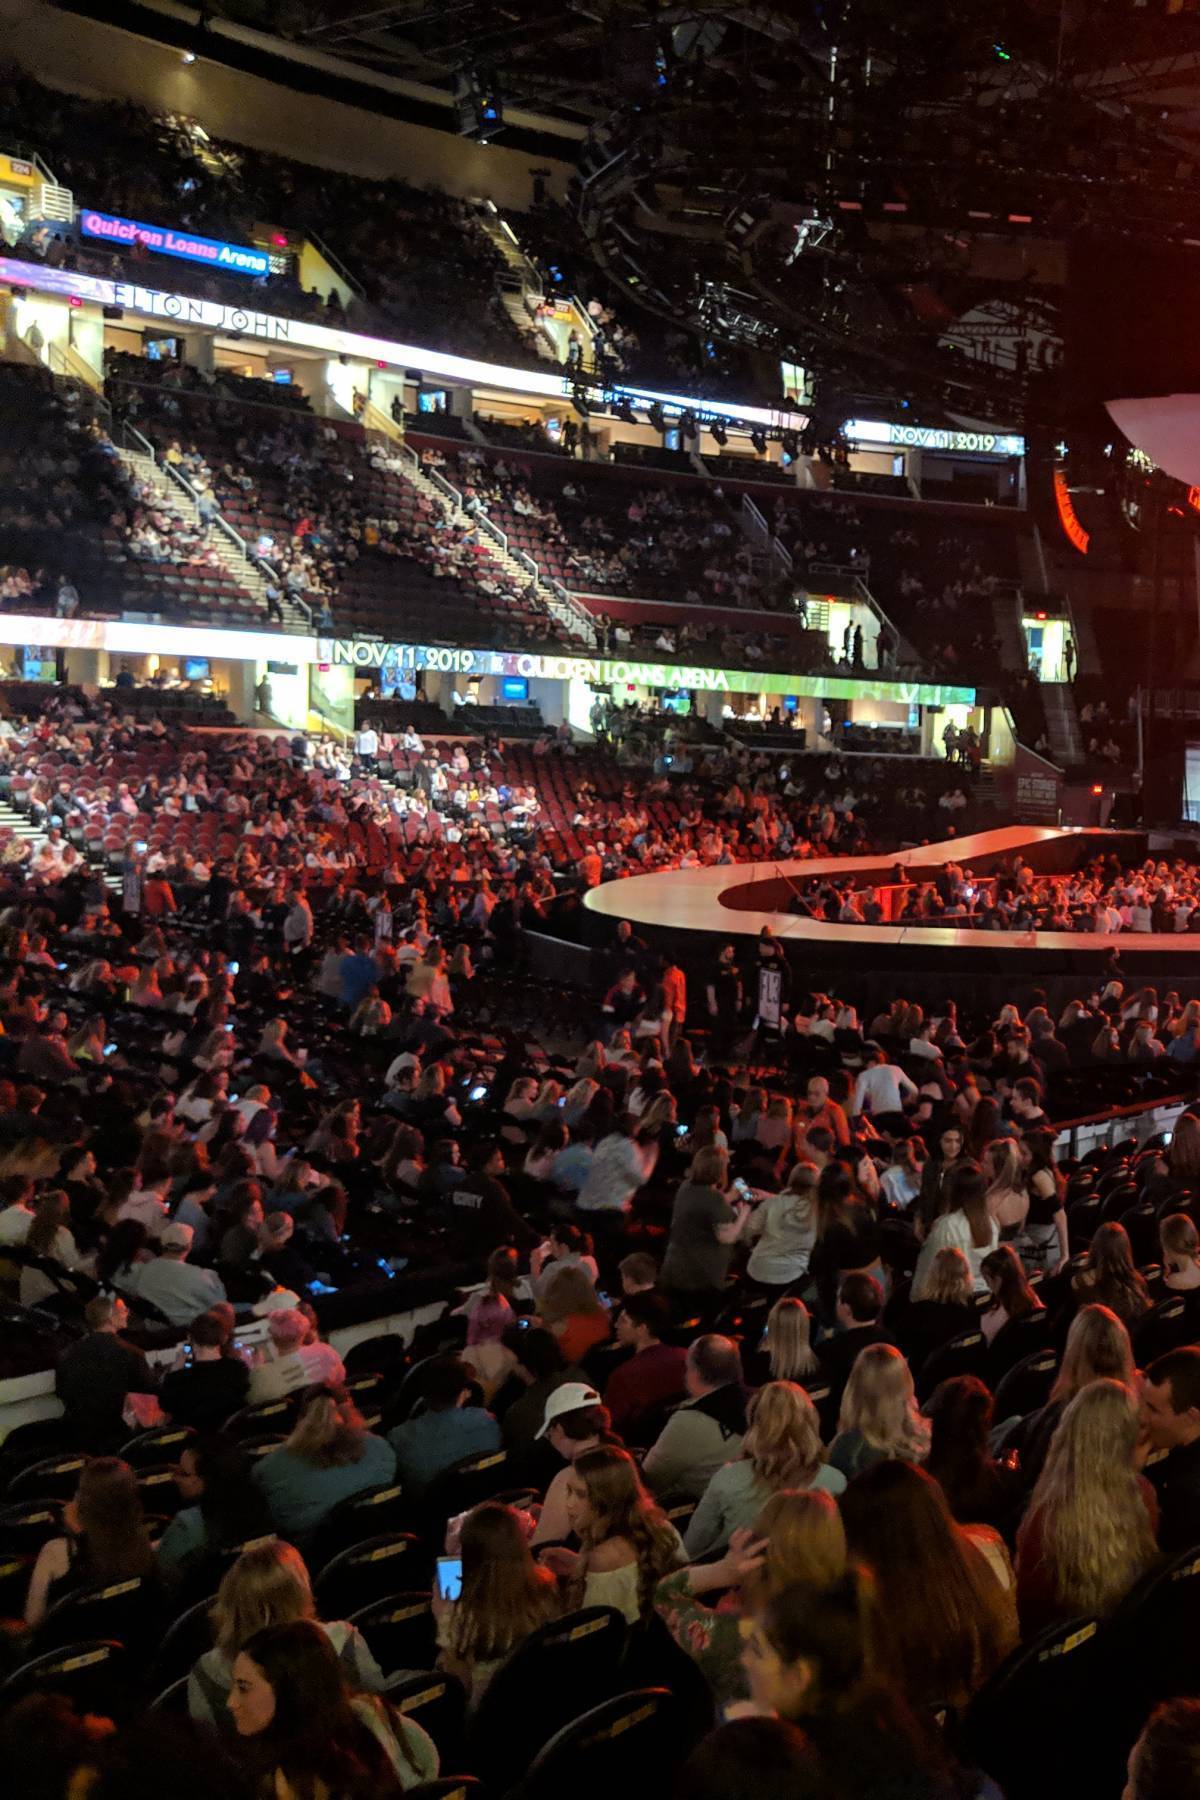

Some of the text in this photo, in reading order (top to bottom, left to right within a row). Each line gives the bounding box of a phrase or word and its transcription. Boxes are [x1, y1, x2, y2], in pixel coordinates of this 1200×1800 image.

[86, 215, 267, 271] Quicken Loans Arena
[113, 284, 290, 339] ELTON JOHN
[891, 426, 931, 447] NOV
[957, 432, 996, 451] 2019
[334, 641, 390, 666] NOV
[425, 649, 475, 672] 2019
[517, 654, 730, 691] QUICKEN LOANS ARENA
